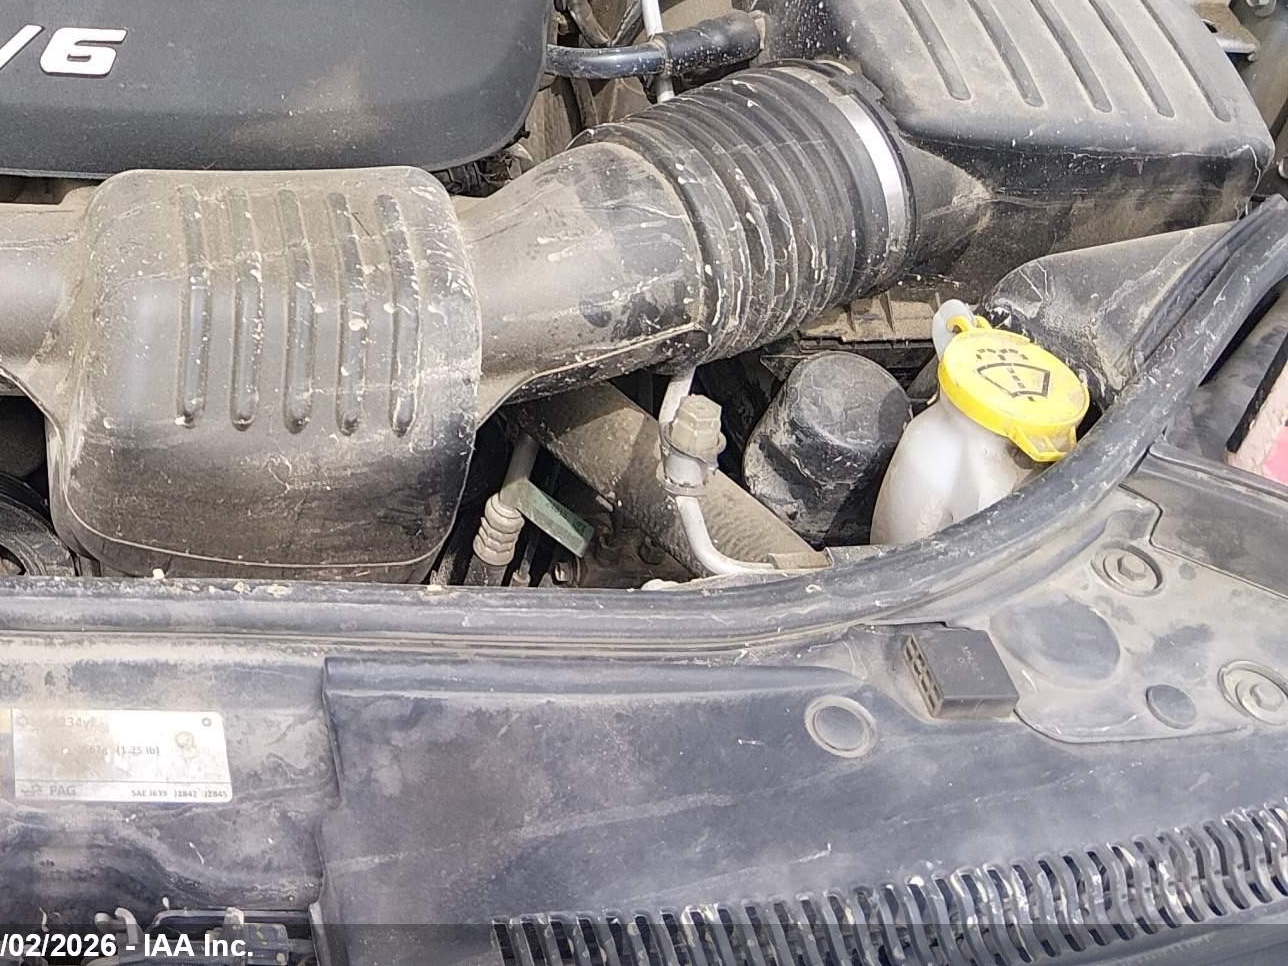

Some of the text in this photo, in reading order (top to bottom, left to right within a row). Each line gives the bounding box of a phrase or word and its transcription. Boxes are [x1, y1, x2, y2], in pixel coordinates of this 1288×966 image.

[116, 745, 144, 756] (1.25
[145, 745, 161, 756] lb)
[49, 784, 77, 796] PAG
[130, 788, 147, 797] SAE
